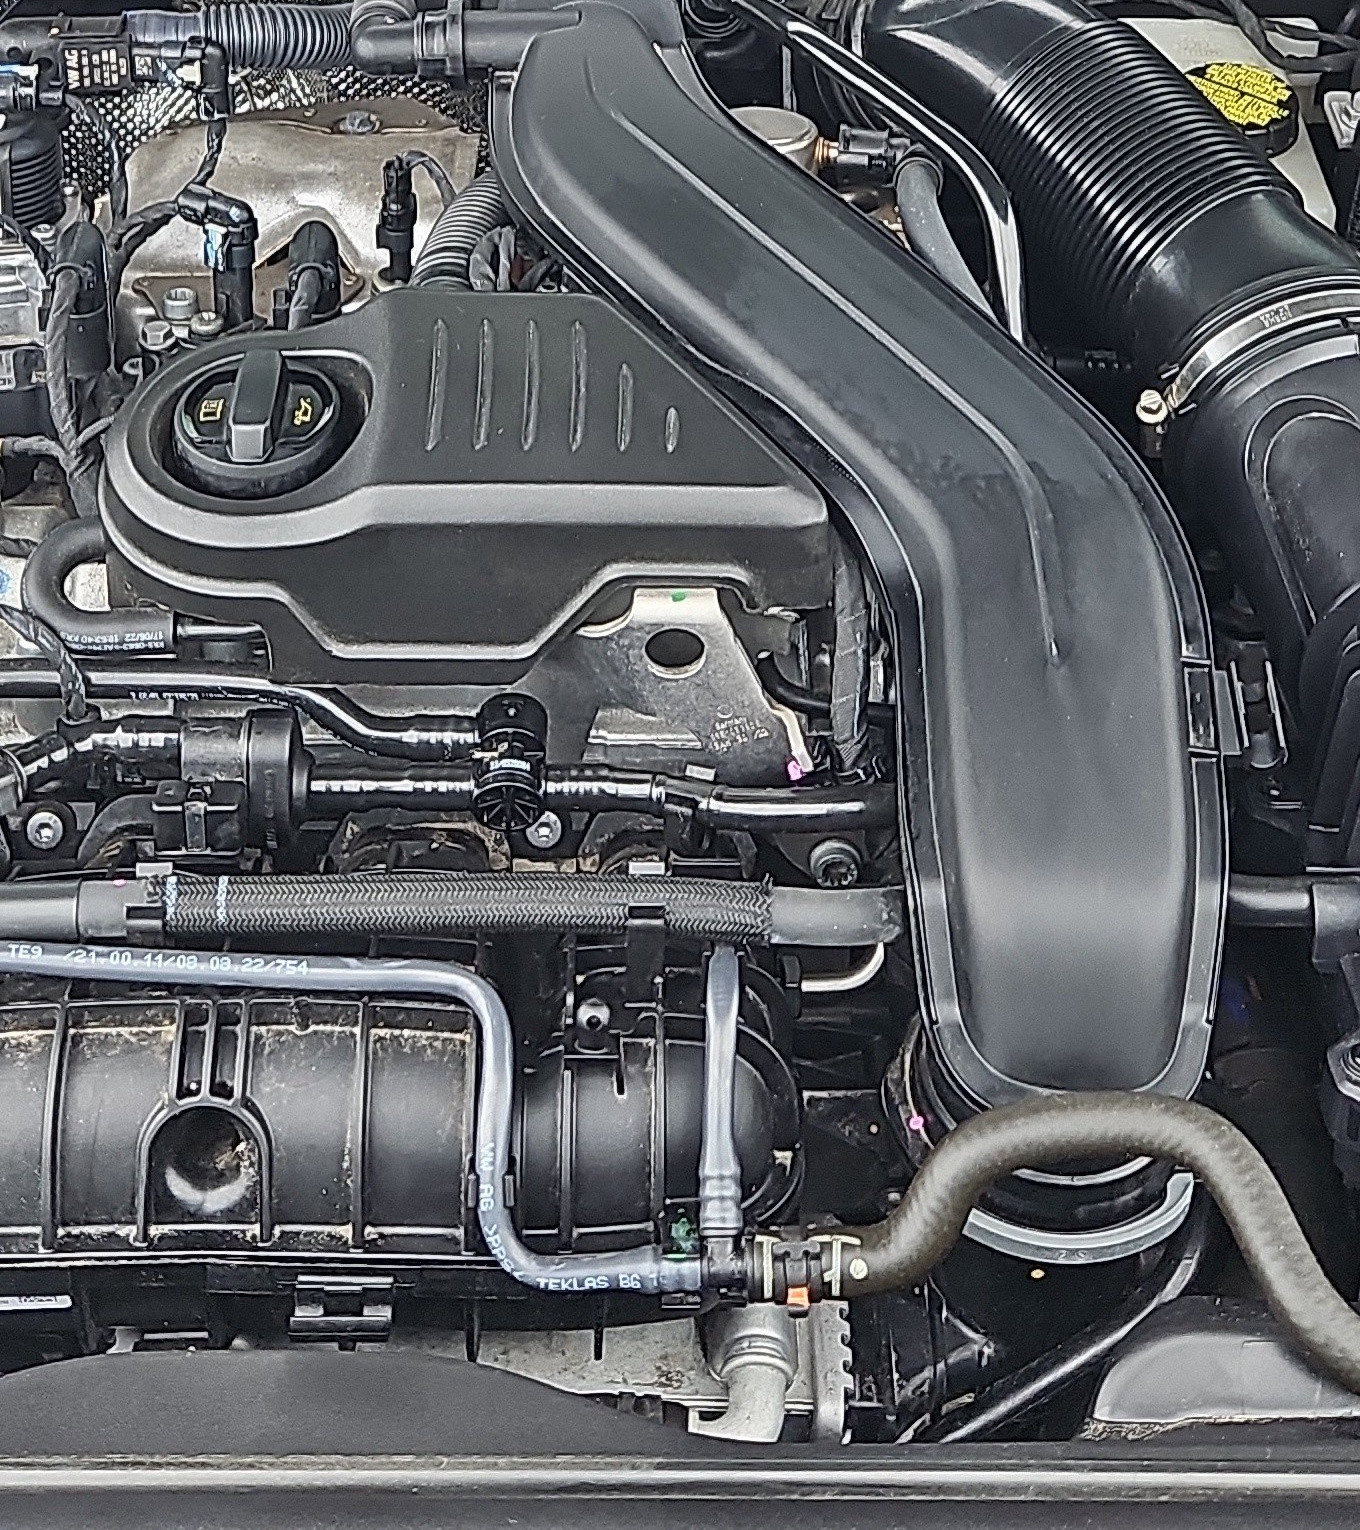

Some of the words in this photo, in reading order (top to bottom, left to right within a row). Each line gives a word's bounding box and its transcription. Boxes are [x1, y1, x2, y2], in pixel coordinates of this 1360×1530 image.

[8, 944, 43, 959] TE9
[479, 1142, 495, 1171] VW
[478, 1183, 495, 1212] AG
[535, 1274, 610, 1291] TEKLAS
[618, 1272, 642, 1289] BG
